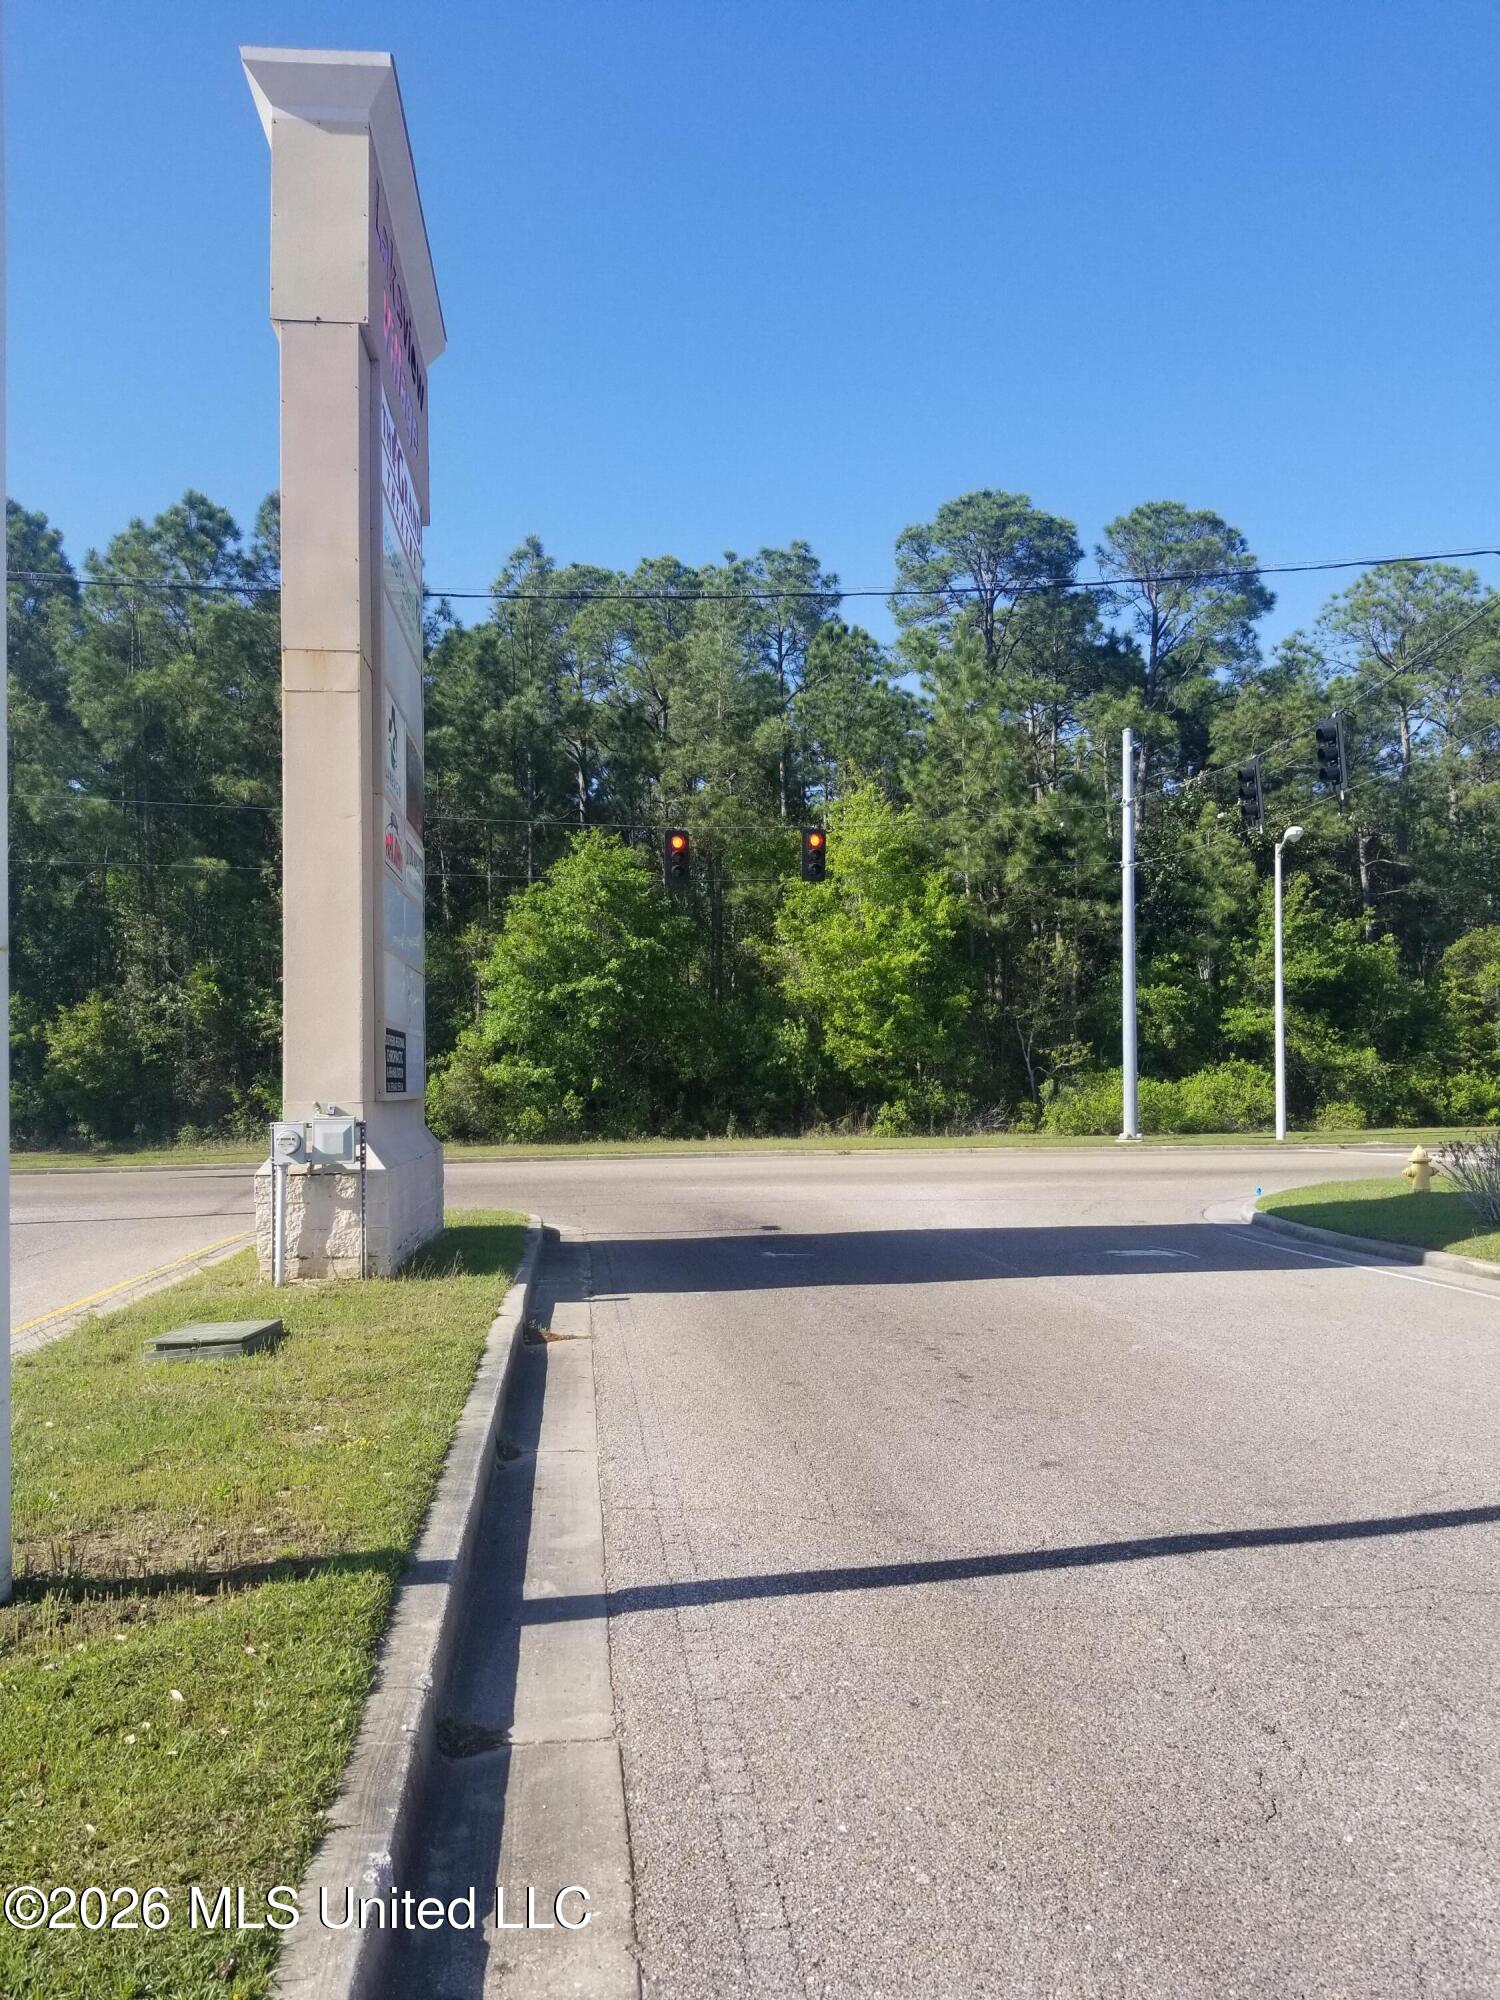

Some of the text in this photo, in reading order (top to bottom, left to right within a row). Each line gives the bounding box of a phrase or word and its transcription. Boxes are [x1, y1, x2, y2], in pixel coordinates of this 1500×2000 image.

[383, 288, 419, 456] Village
[387, 468, 417, 570] THEATRE
[397, 447, 421, 545] GRAND
